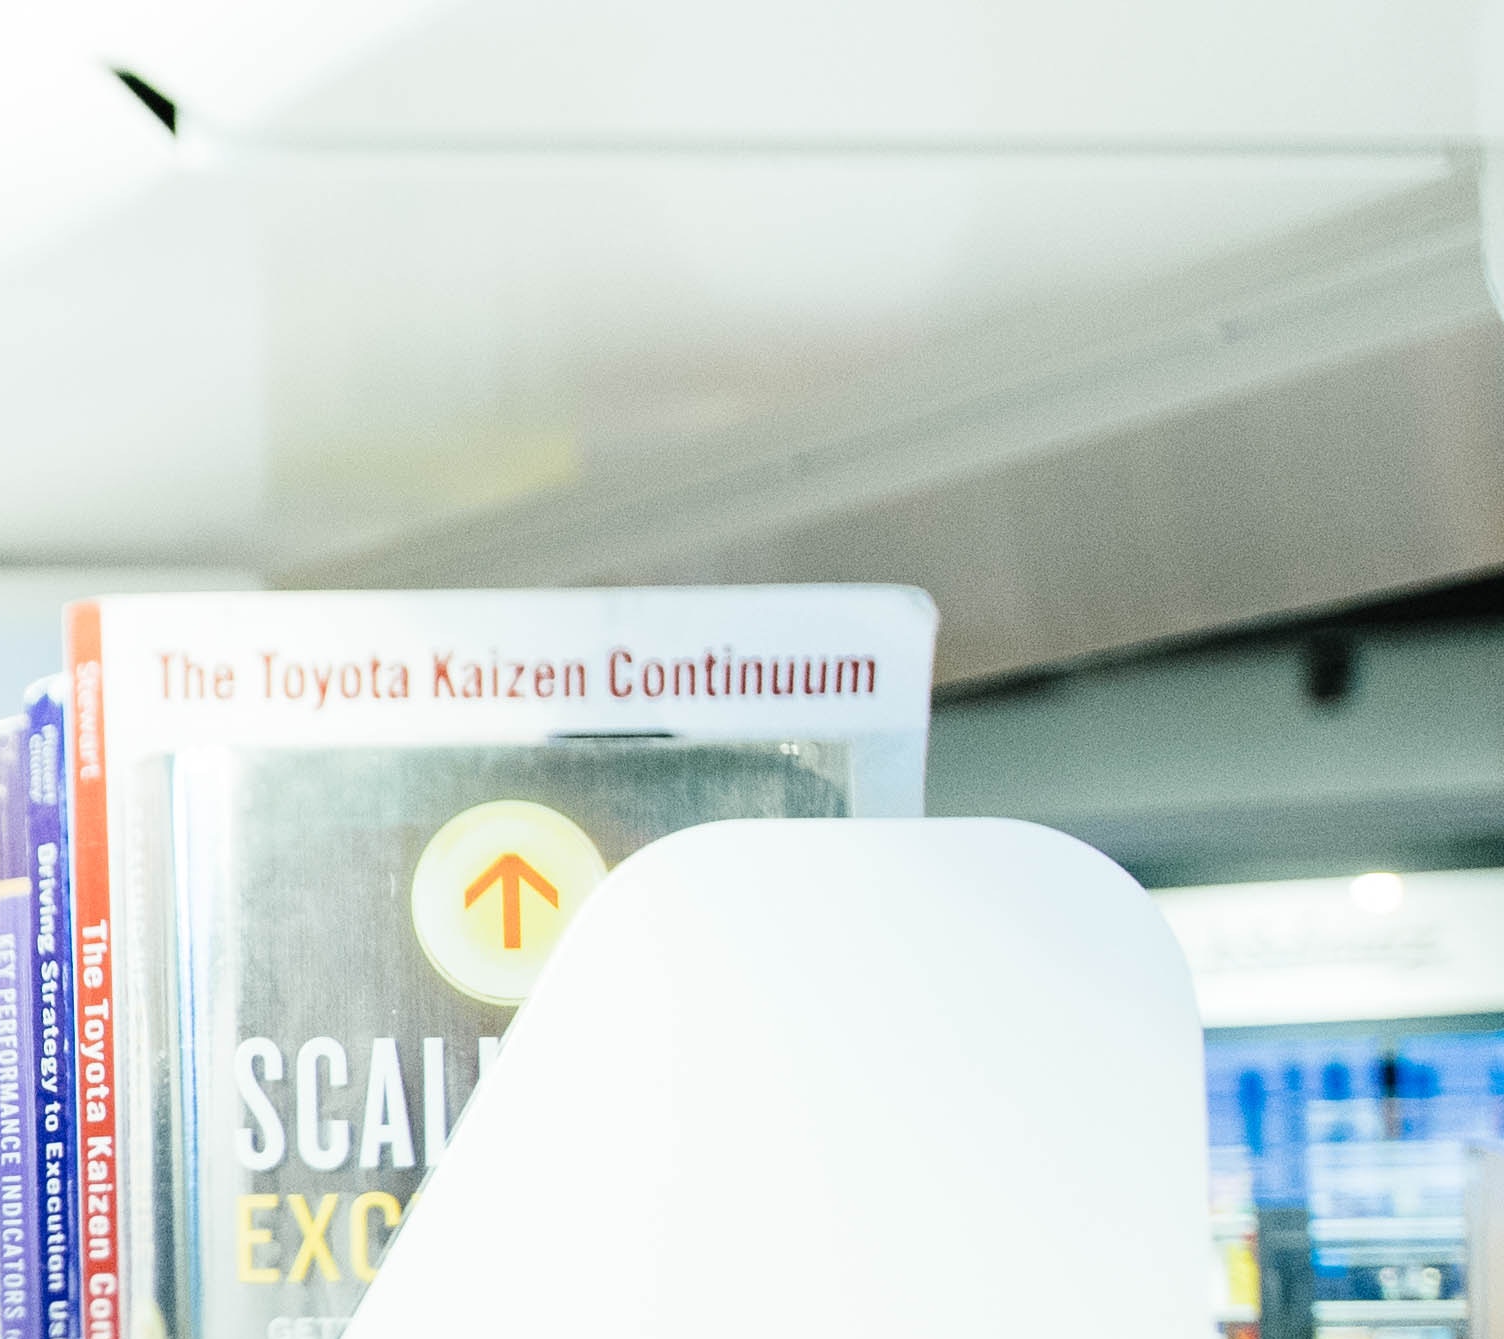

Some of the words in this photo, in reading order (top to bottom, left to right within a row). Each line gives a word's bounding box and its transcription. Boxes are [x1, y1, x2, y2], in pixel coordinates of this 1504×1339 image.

[75, 660, 101, 780] Stewart
[157, 651, 236, 701] The
[258, 649, 412, 711] Toyota
[432, 646, 588, 700] Kaizen
[606, 646, 879, 699] Continuum
[36, 843, 58, 956] Driving
[82, 920, 108, 989] The
[39, 960, 62, 1092] Strategy
[79, 999, 112, 1123] Toyota
[43, 1101, 61, 1132] to
[0, 1174, 25, 1320] INDICATORS
[45, 1141, 66, 1291] Execution
[86, 1135, 115, 1260] Kaizen
